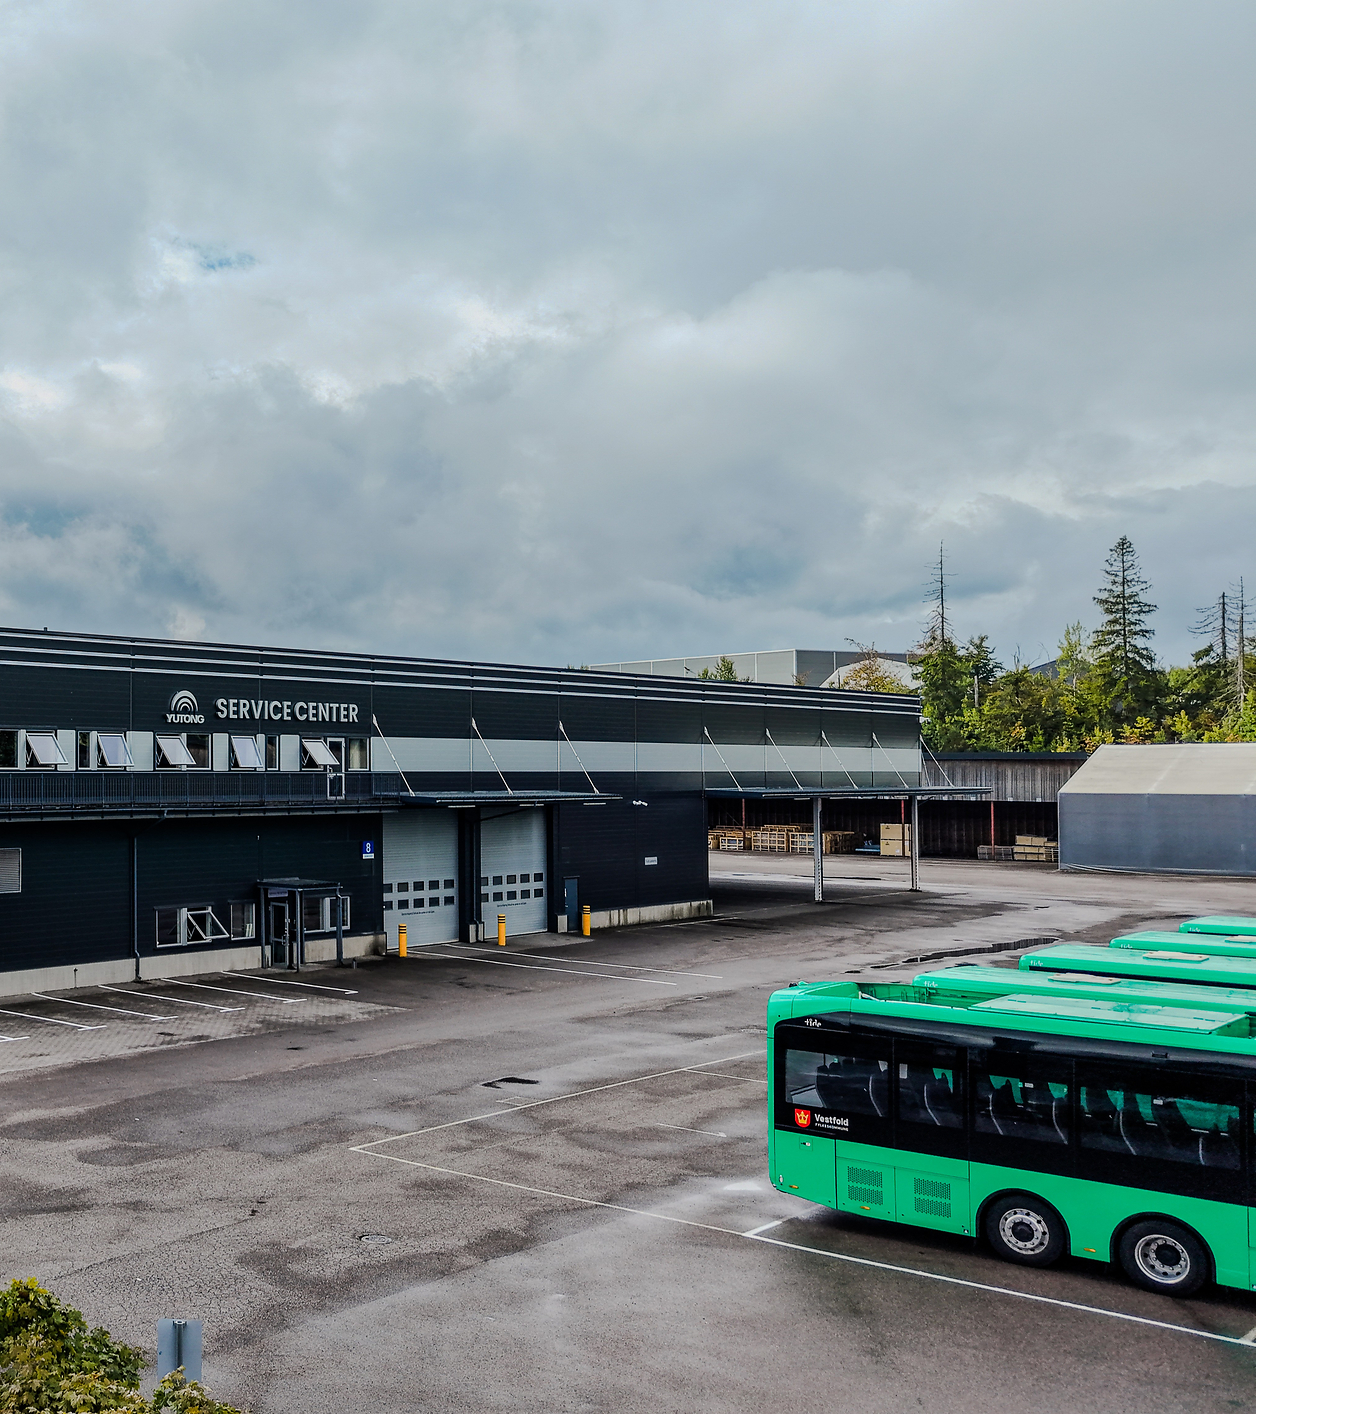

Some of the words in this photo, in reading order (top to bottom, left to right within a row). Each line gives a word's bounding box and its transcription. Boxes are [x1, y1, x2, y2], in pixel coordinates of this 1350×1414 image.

[215, 698, 292, 721] SERVICE
[294, 701, 359, 723] CENTER
[165, 713, 205, 724] YUTONG
[365, 842, 371, 853] 8
[814, 1113, 849, 1127] Vestfold
